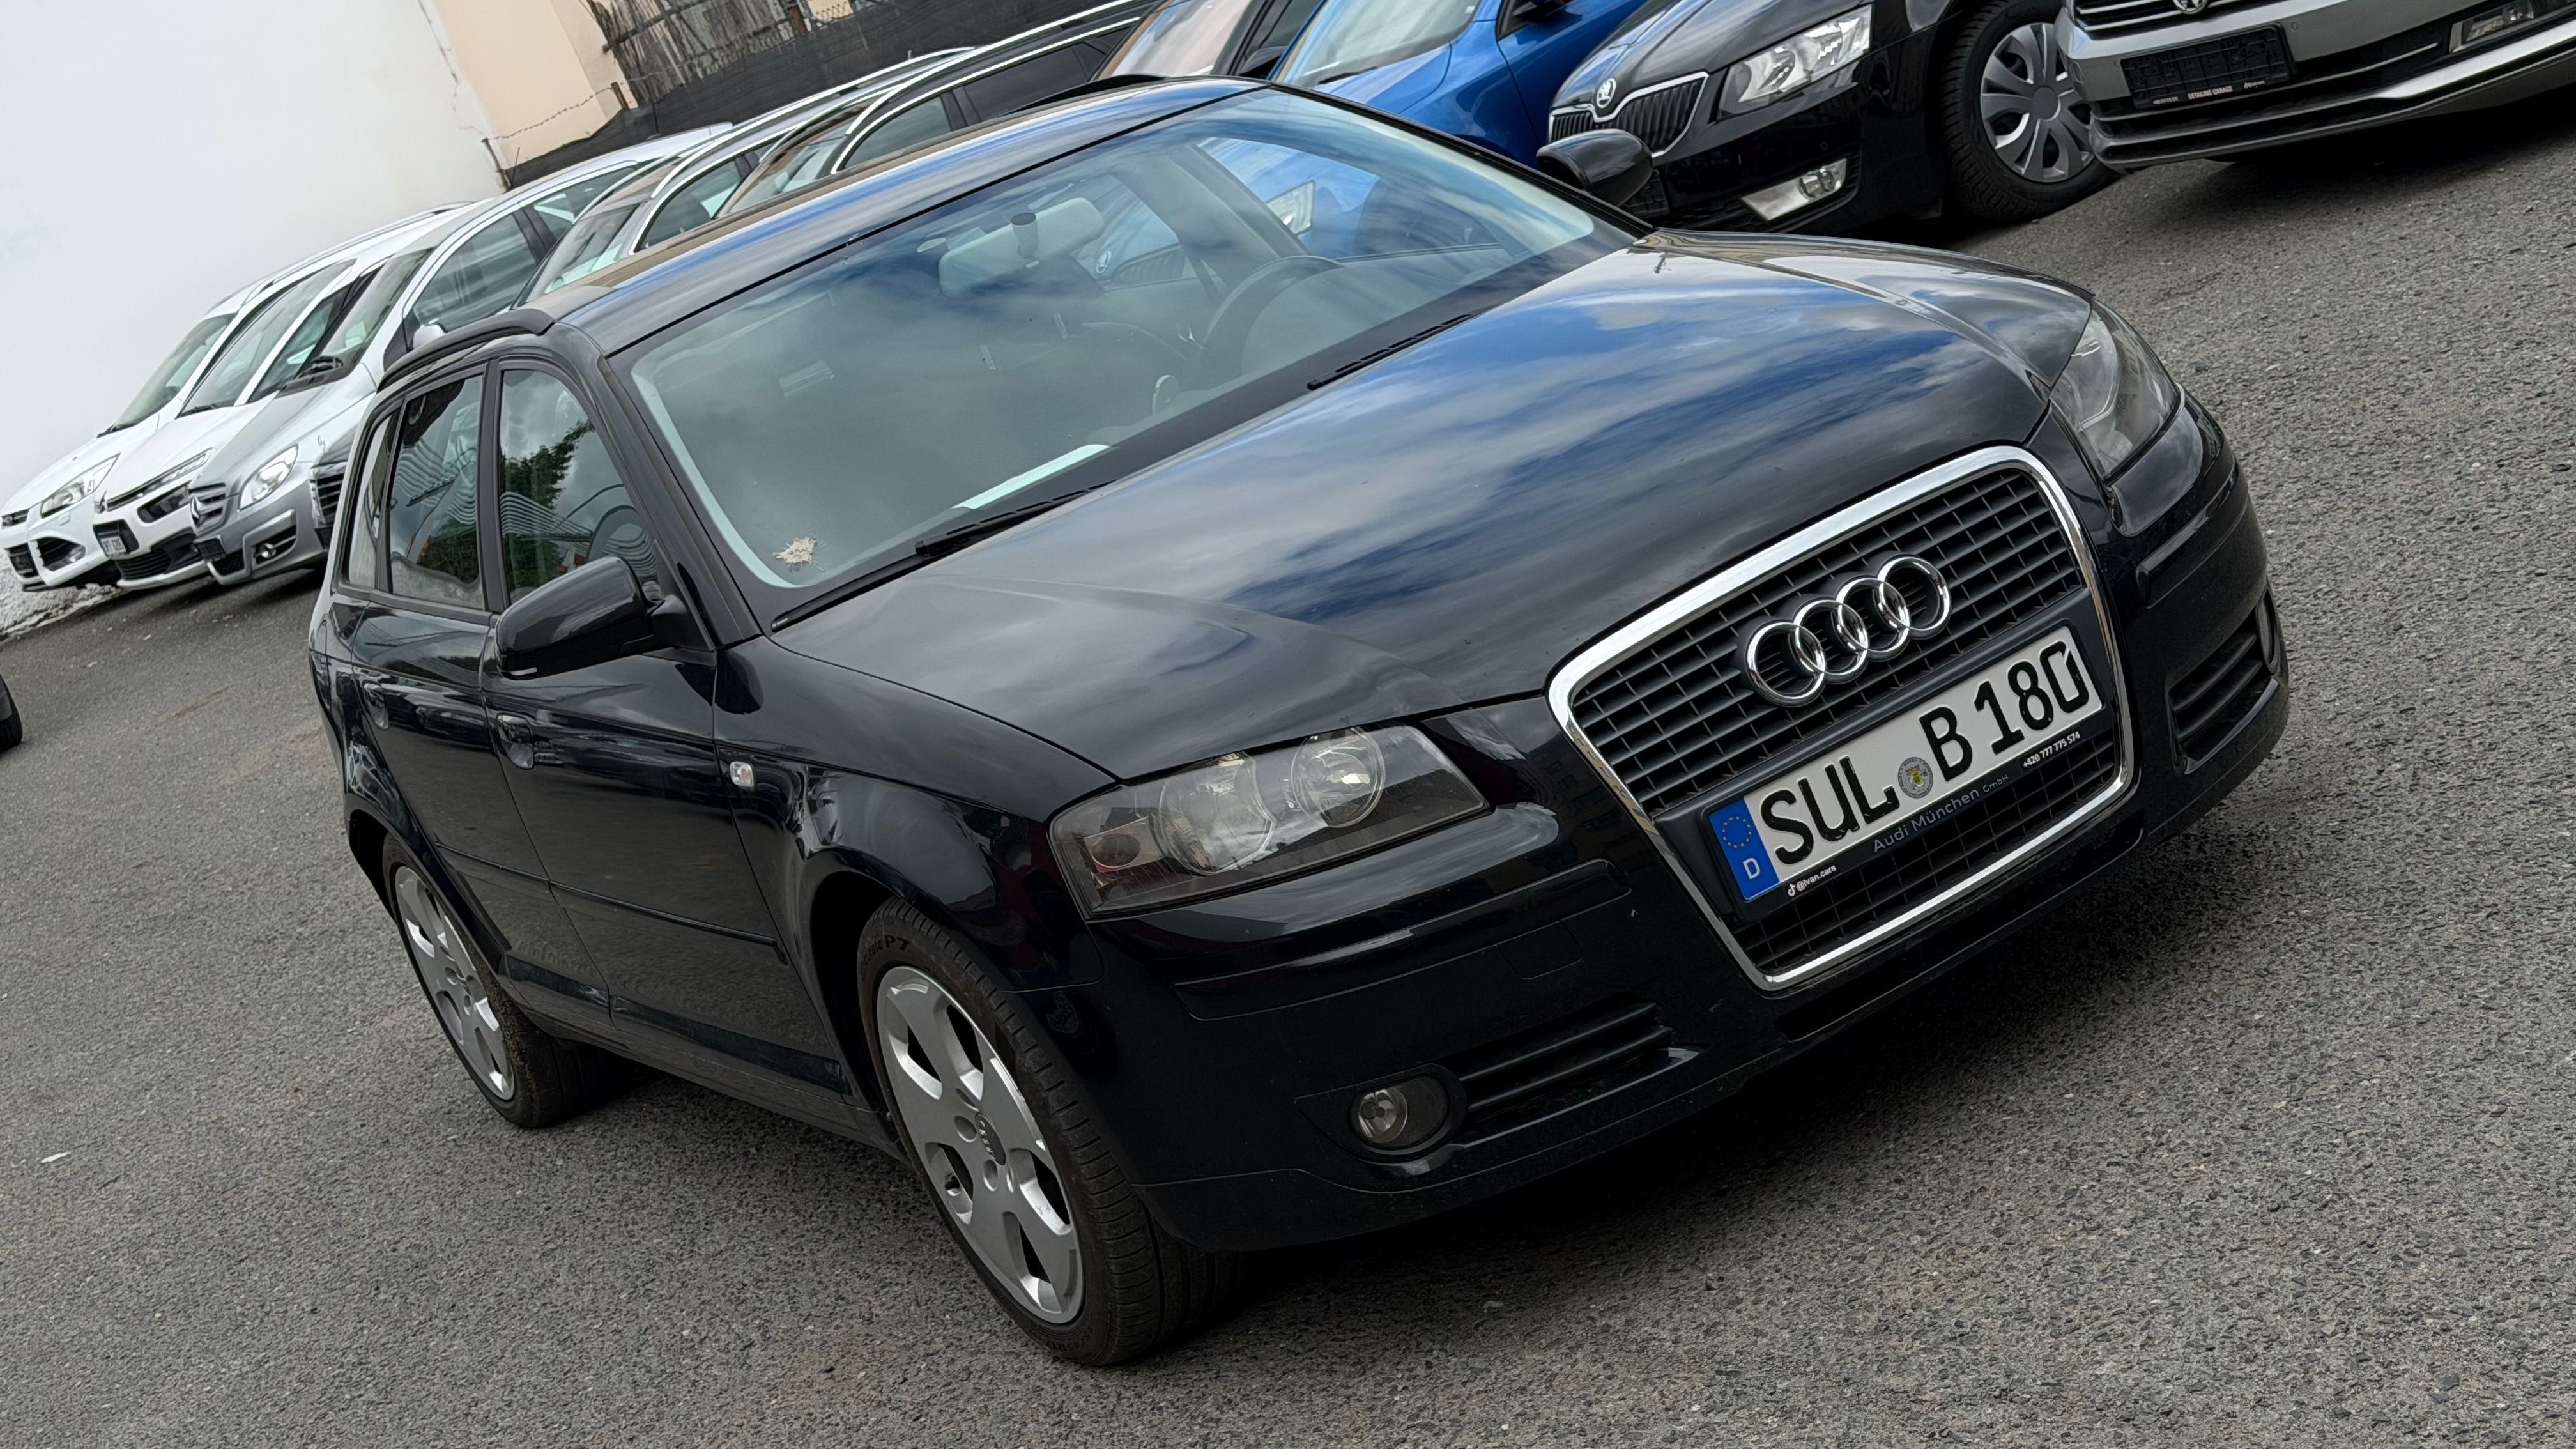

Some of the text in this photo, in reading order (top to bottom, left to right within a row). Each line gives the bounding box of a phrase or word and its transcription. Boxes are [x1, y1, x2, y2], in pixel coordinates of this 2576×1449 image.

[2212, 86, 2233, 95] GARAGE
[1760, 640, 2090, 865] SUL B 180
[2023, 731, 2081, 768] +420 777 775 574
[1874, 774, 2009, 853] Audi München GmbH
[1742, 857, 1761, 880] D
[1796, 864, 1837, 891] @ivan.cars
[884, 935, 910, 951] P7
